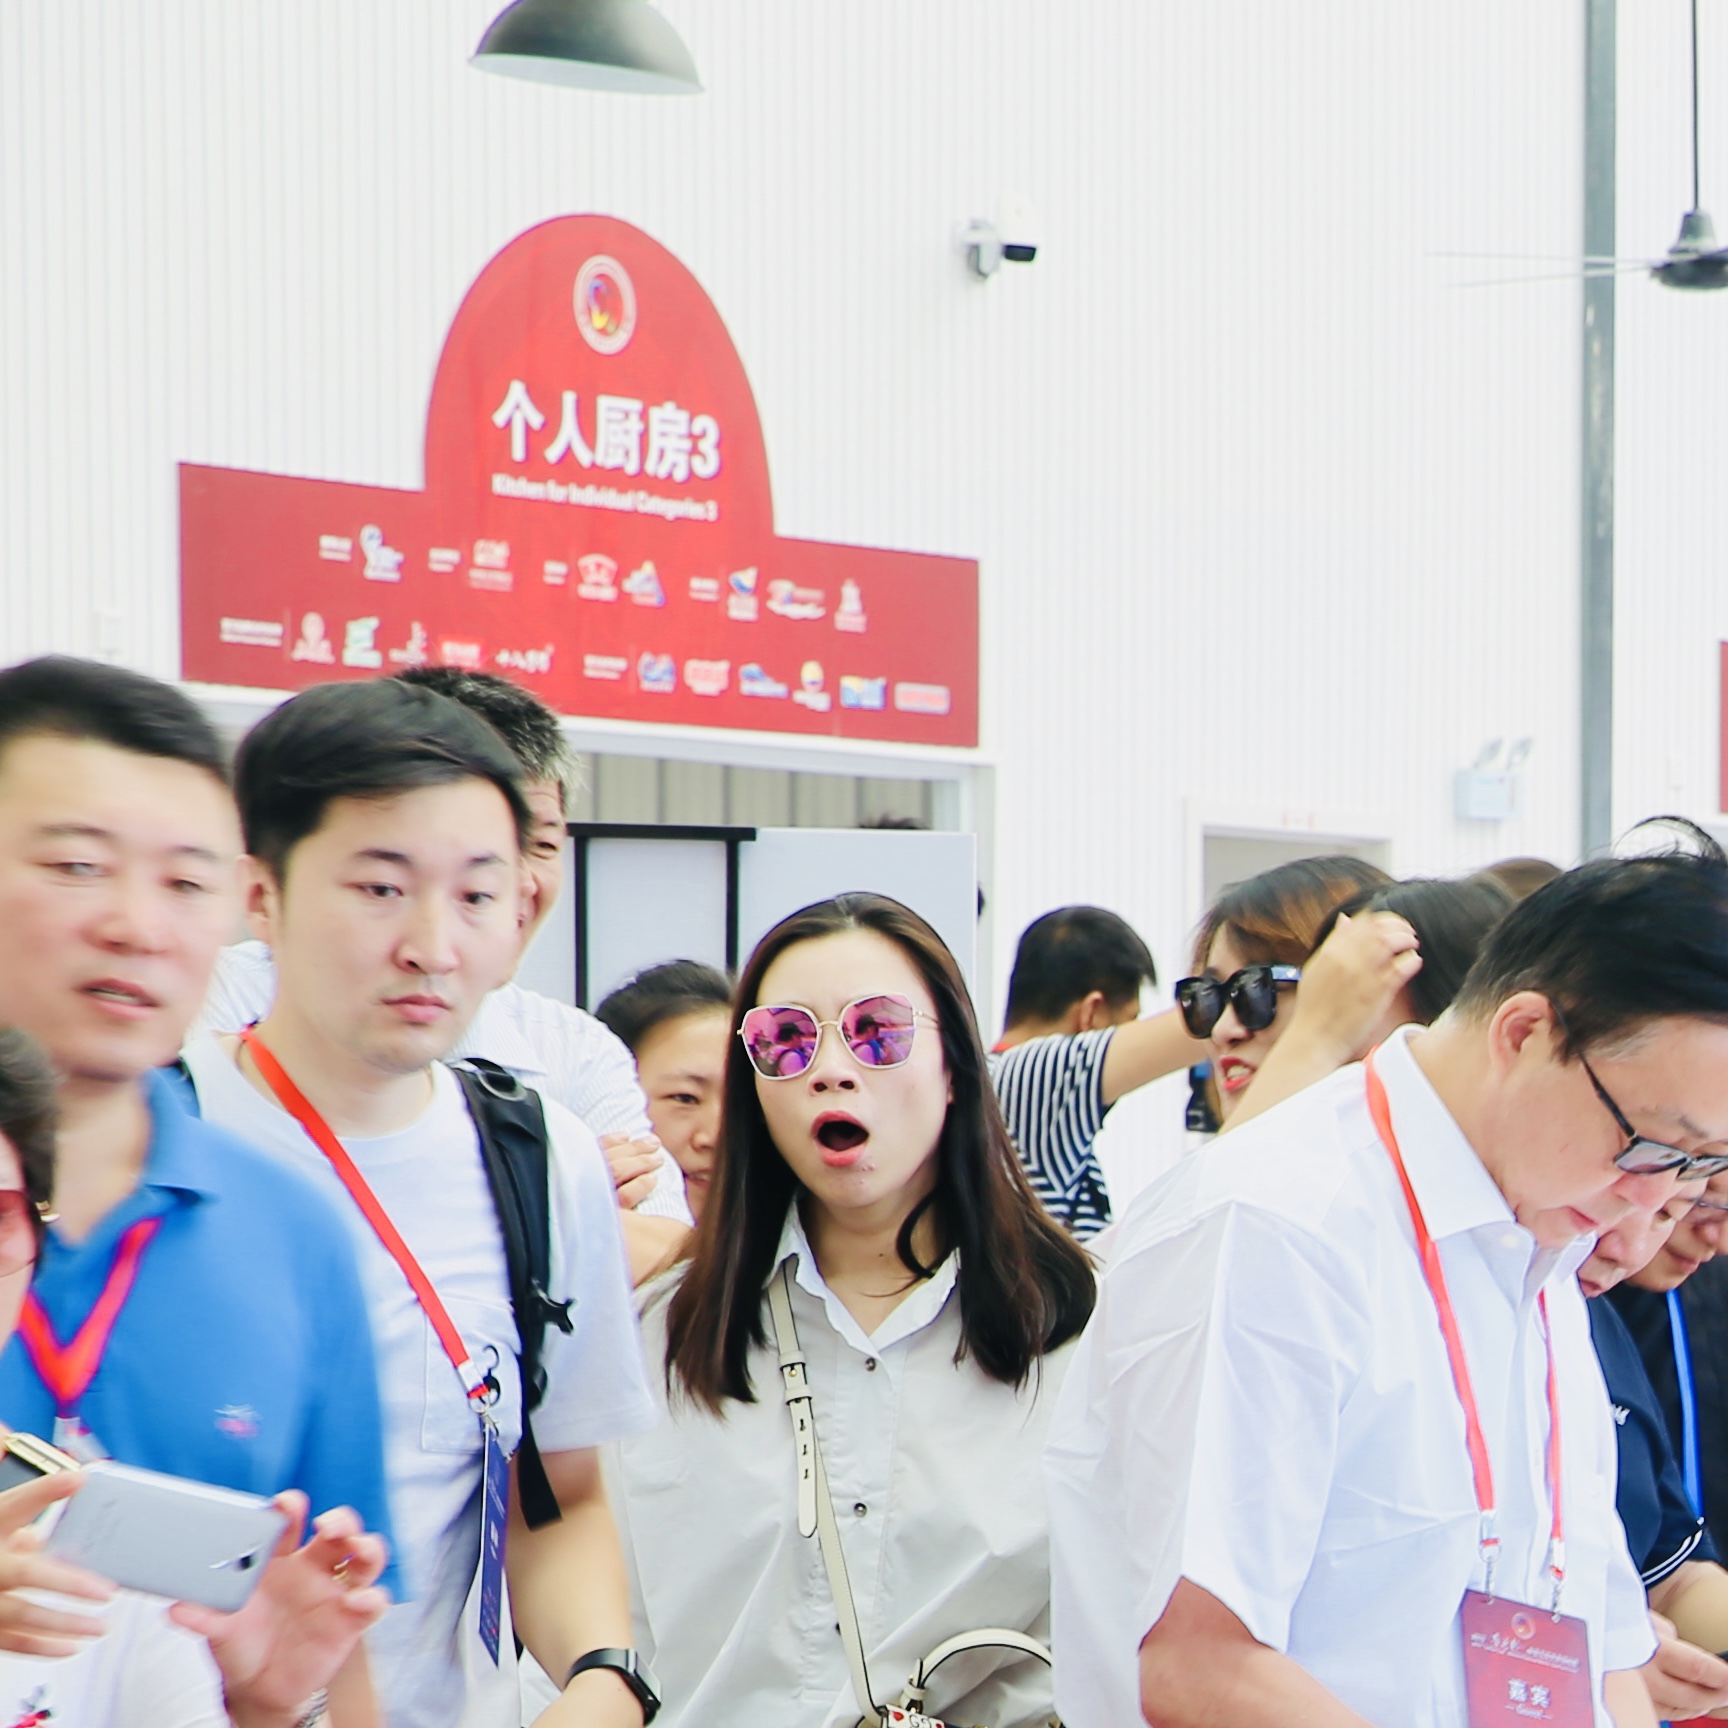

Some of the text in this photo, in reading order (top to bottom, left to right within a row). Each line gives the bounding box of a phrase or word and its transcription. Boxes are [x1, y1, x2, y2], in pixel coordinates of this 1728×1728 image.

[492, 379, 720, 483] 个人厨房3
[1508, 1678, 1551, 1709] 嘉宾
